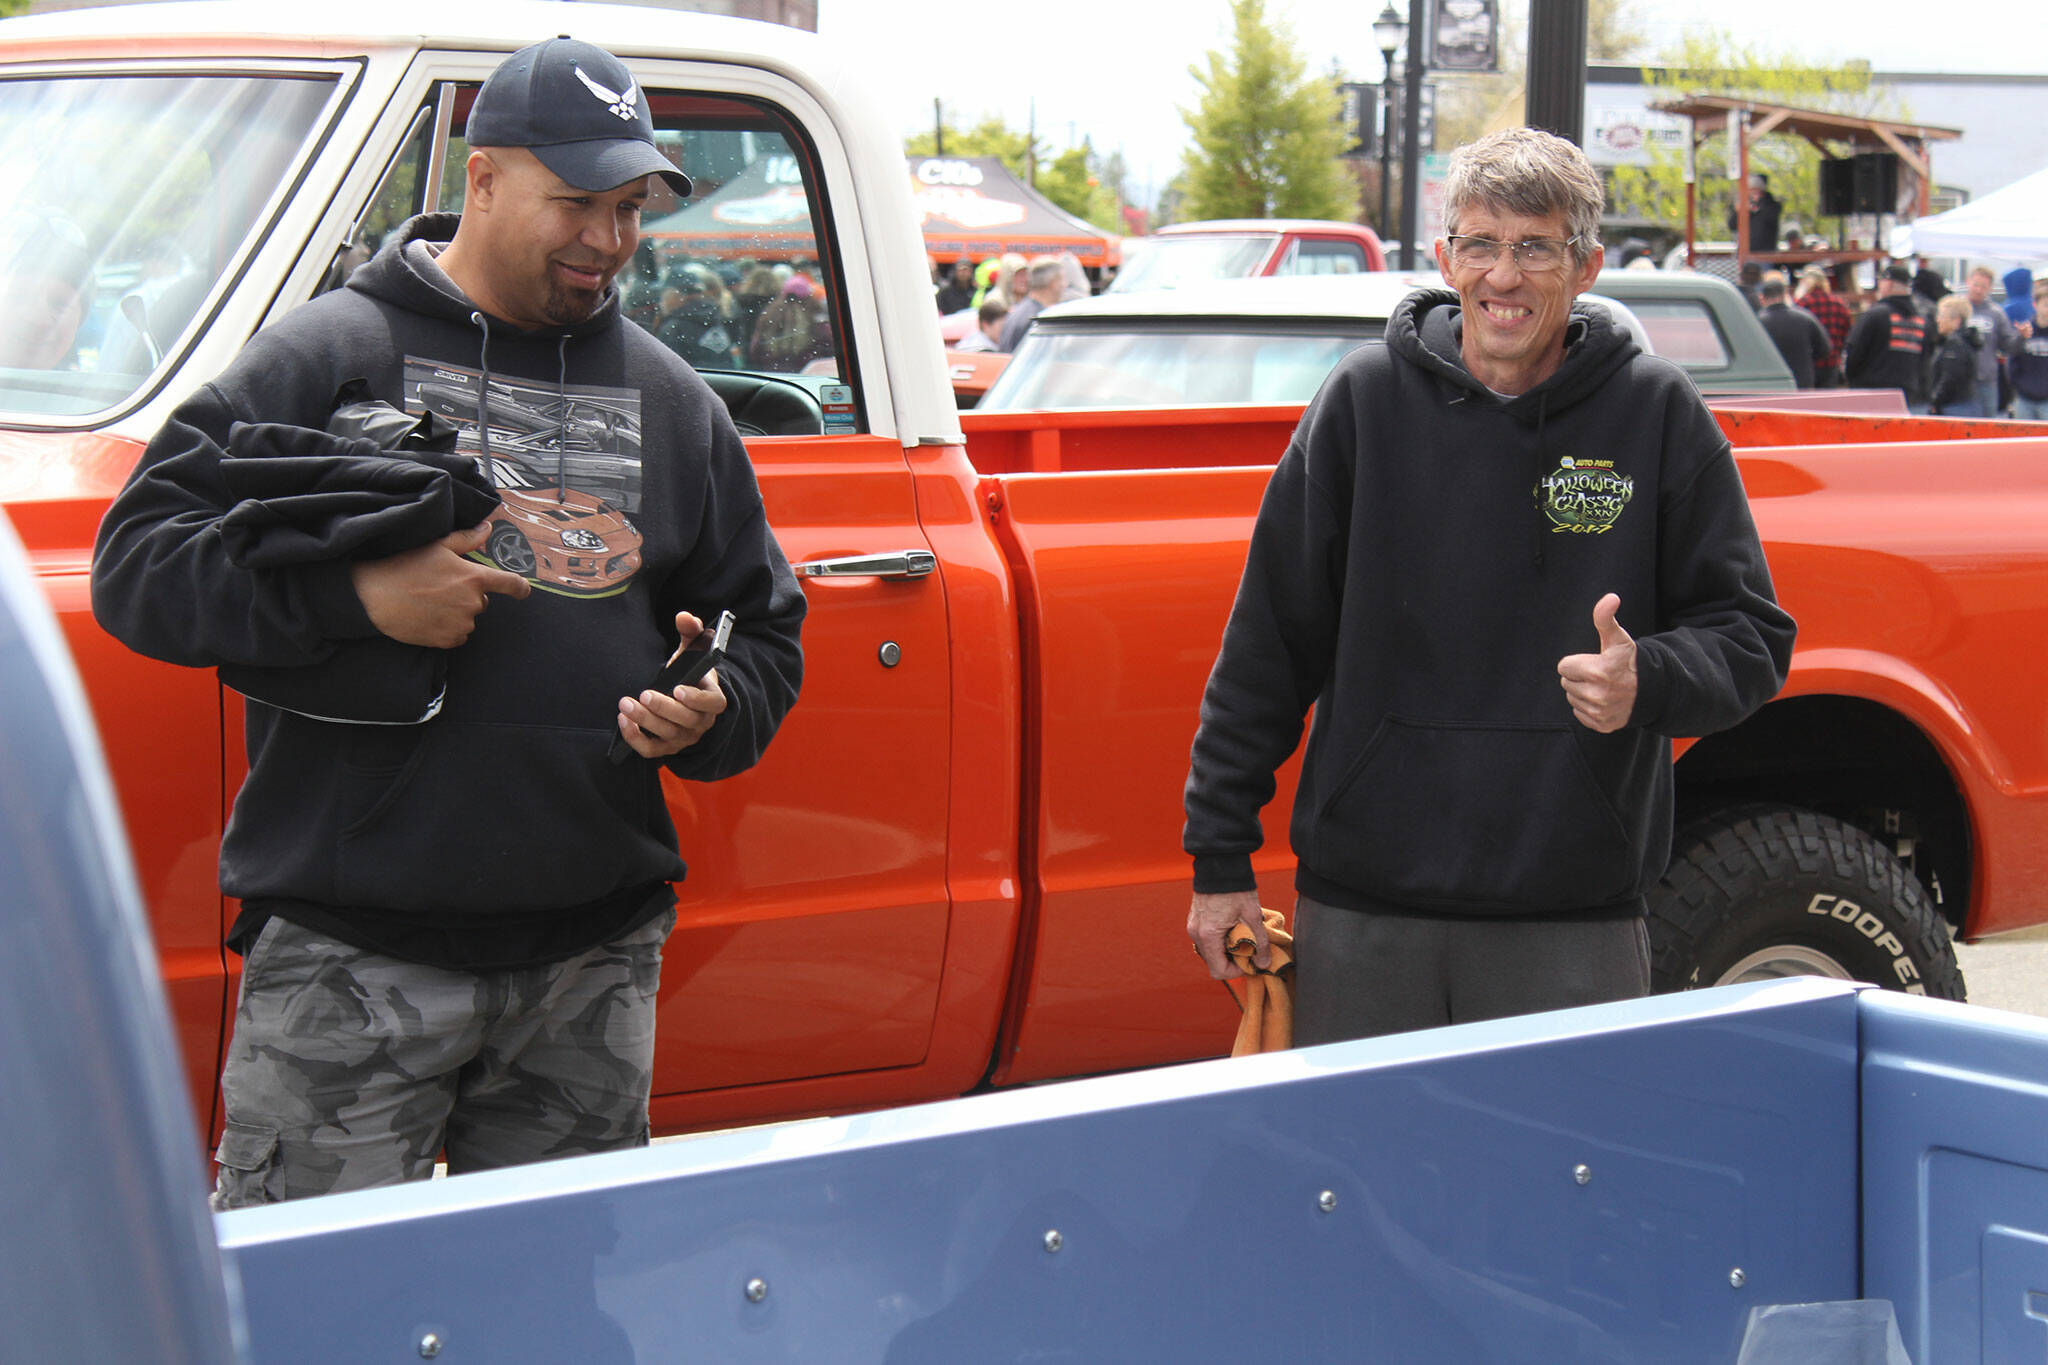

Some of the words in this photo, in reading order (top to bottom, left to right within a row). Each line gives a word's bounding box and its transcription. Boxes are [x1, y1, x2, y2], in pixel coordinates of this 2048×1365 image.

[1575, 459, 1594, 467] AUTO
[1594, 459, 1614, 468] PARTS
[1555, 493, 1621, 513] CLASSIC
[1551, 523, 1614, 535] 2017
